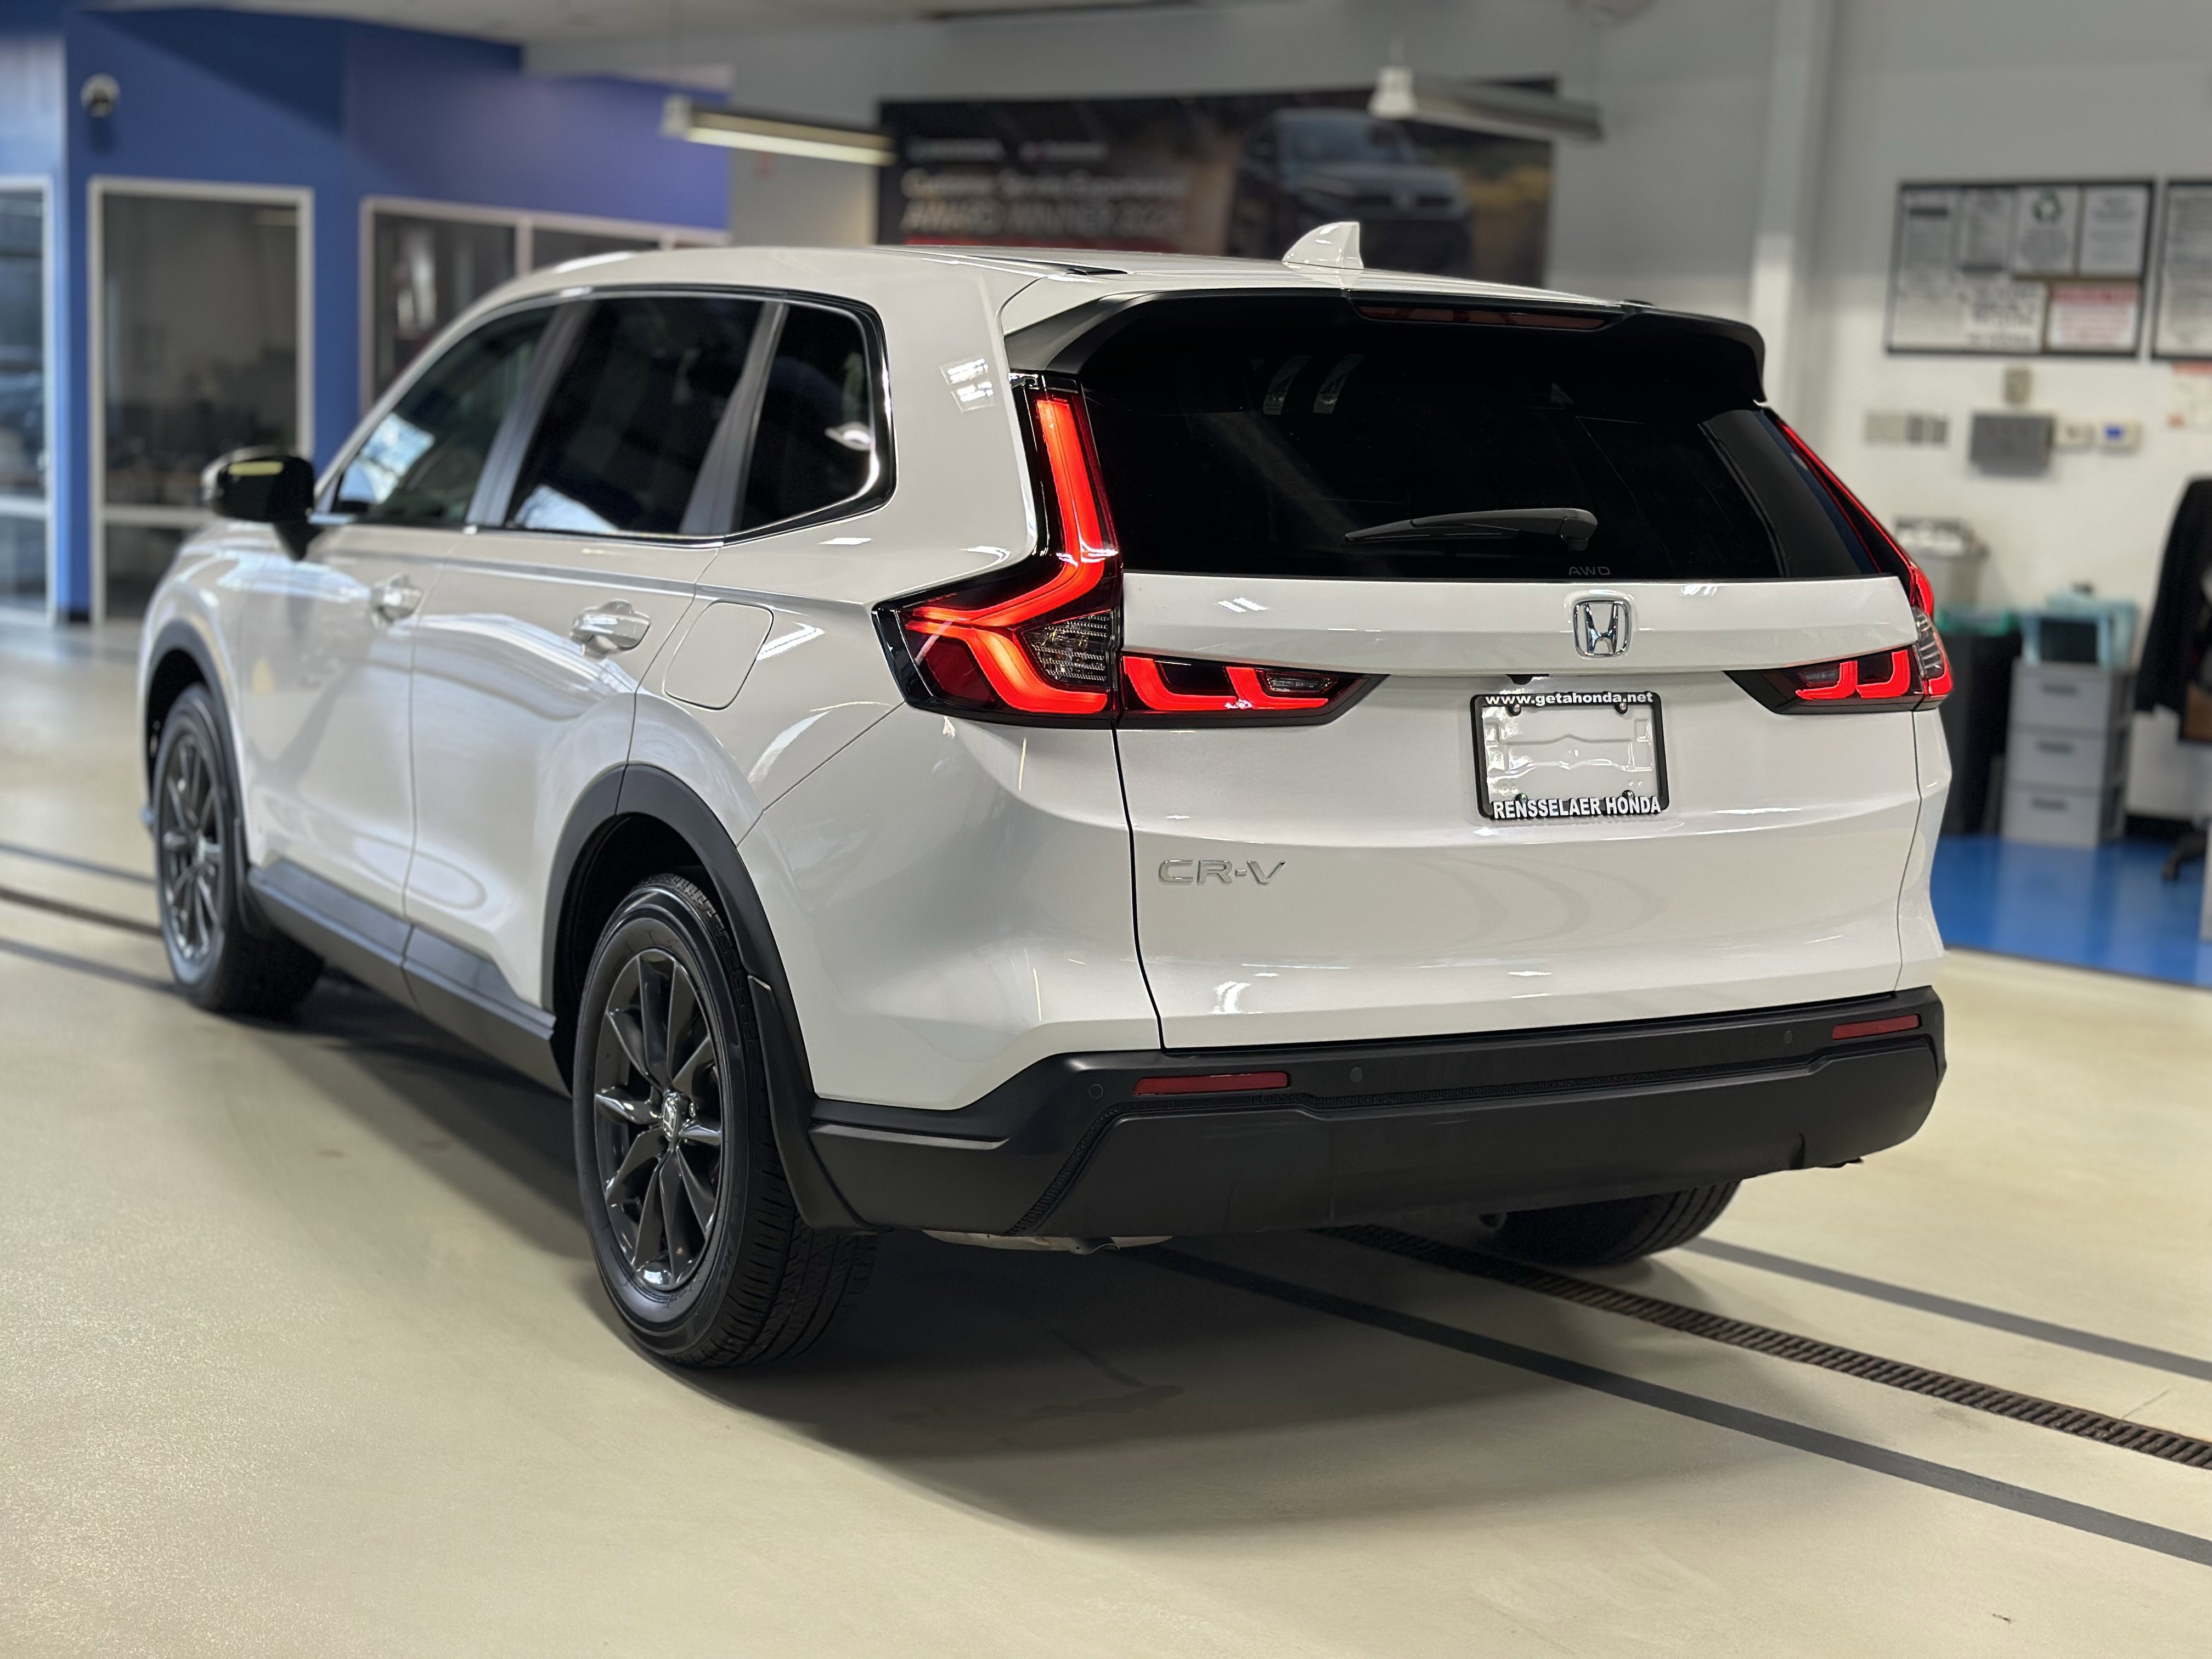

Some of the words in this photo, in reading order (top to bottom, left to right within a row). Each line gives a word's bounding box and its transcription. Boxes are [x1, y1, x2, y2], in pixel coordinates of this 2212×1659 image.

[1568, 566, 1611, 575] AWD
[1485, 692, 1654, 707] www.getahonda.net
[1493, 798, 1601, 819] RENSSELAER
[1606, 797, 1661, 815] HONDA
[1158, 859, 1286, 885] CR-V
